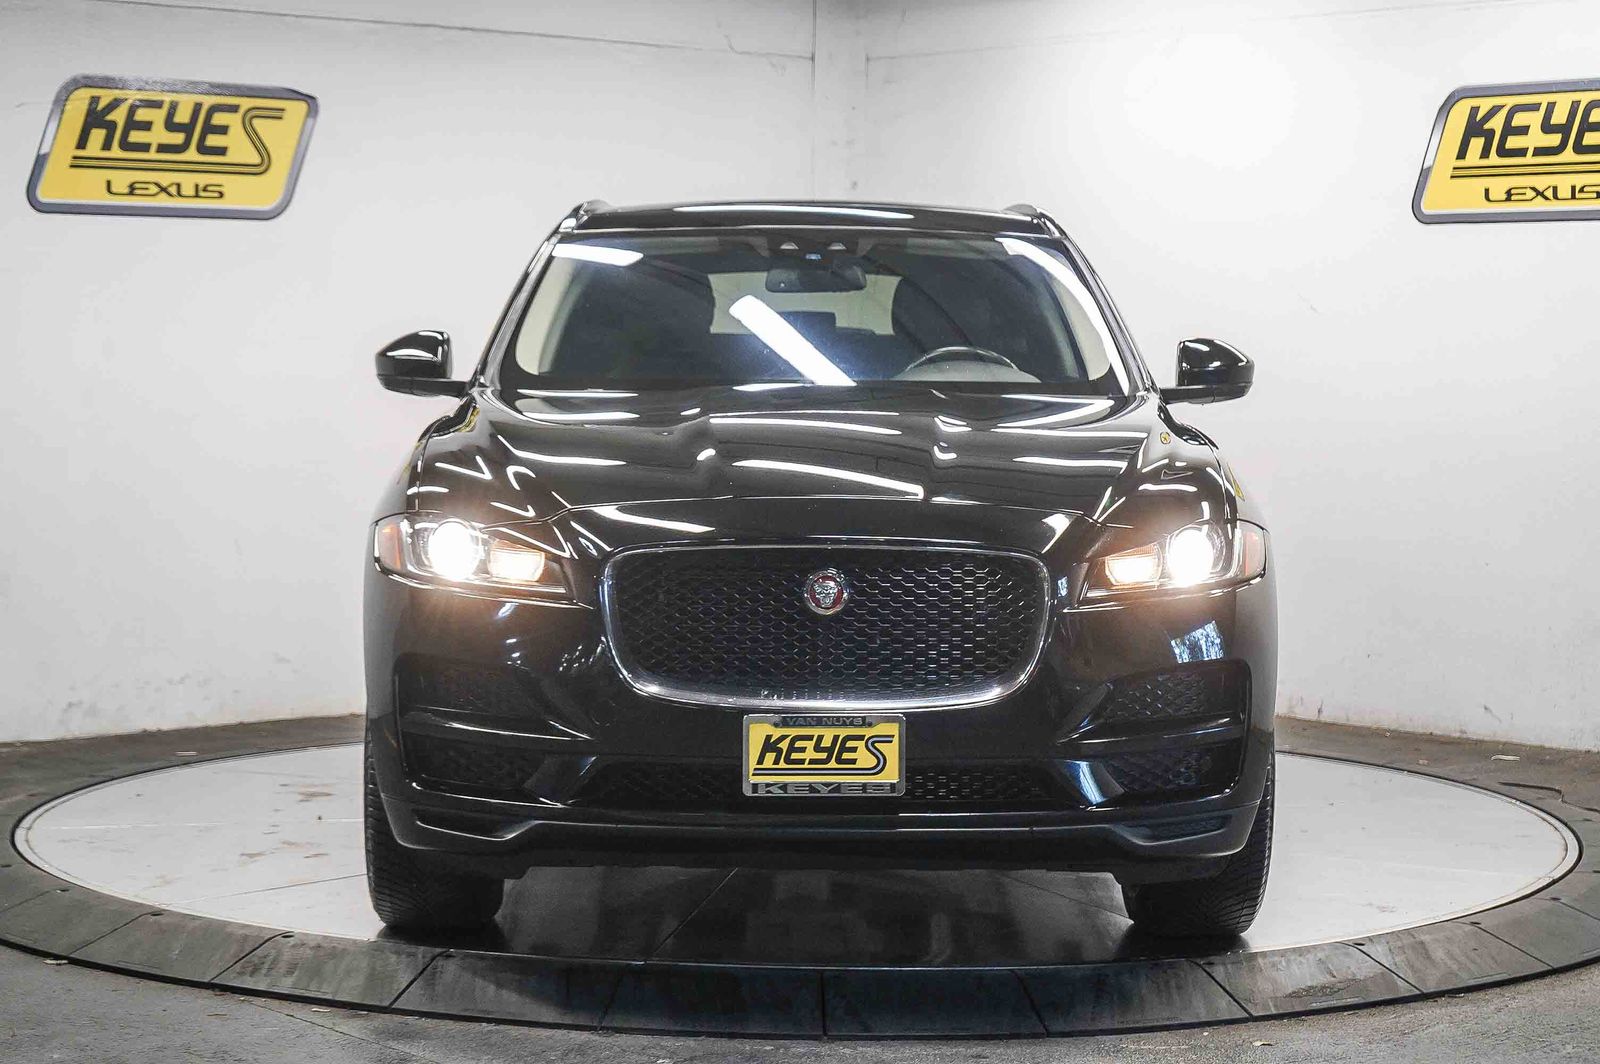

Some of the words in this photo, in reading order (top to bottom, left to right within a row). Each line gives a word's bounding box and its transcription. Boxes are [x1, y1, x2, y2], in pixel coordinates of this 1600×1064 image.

[70, 96, 286, 175] KEYES
[1454, 100, 1600, 161] KEYE
[105, 179, 225, 200] LEXUS
[1483, 184, 1600, 203] LEXUS
[785, 717, 817, 726] VAN
[822, 716, 864, 726] NUYS
[752, 734, 896, 776] KEYES
[757, 783, 891, 794] KEYES
